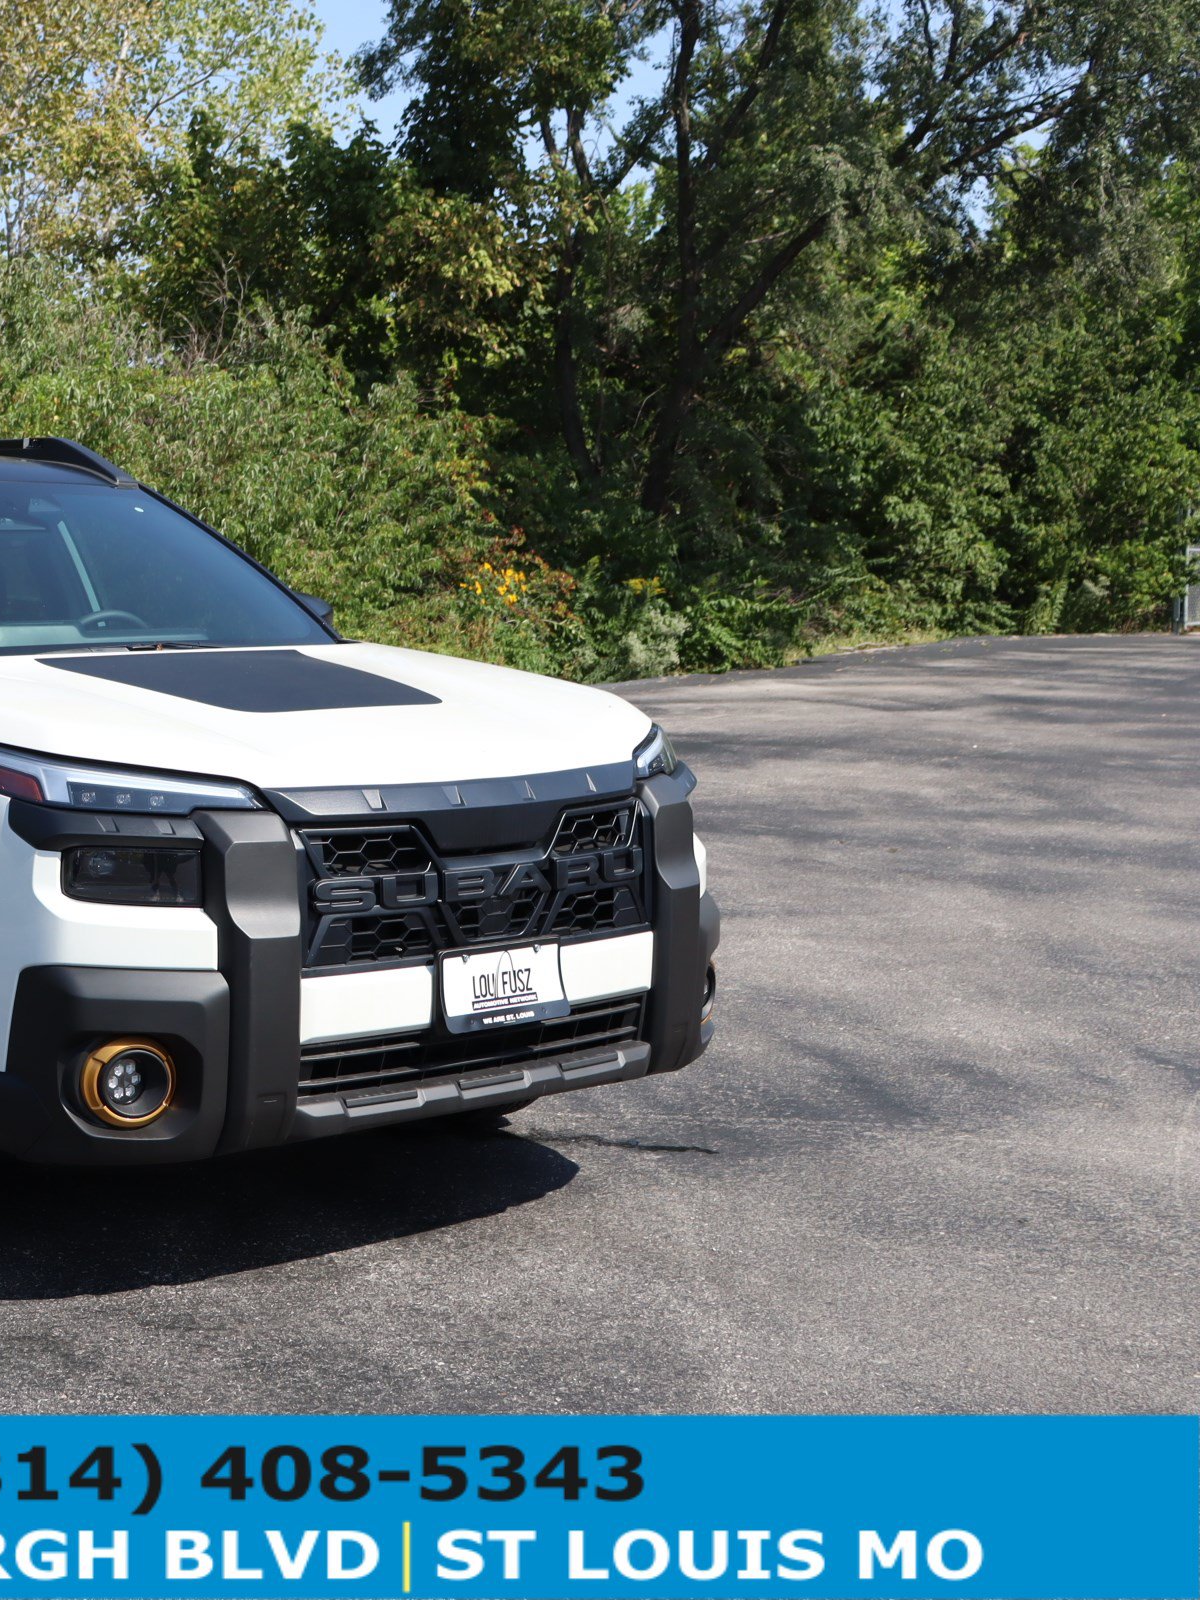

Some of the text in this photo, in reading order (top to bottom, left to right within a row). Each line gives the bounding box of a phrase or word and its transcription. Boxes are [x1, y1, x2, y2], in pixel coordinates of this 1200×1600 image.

[311, 847, 644, 914] SUBARU
[472, 968, 533, 999] LOU FUSZ
[473, 994, 538, 1009] AUTOMOTIVE NETWORK
[493, 1015, 505, 1023] ARE
[516, 1010, 535, 1019] LOUIS
